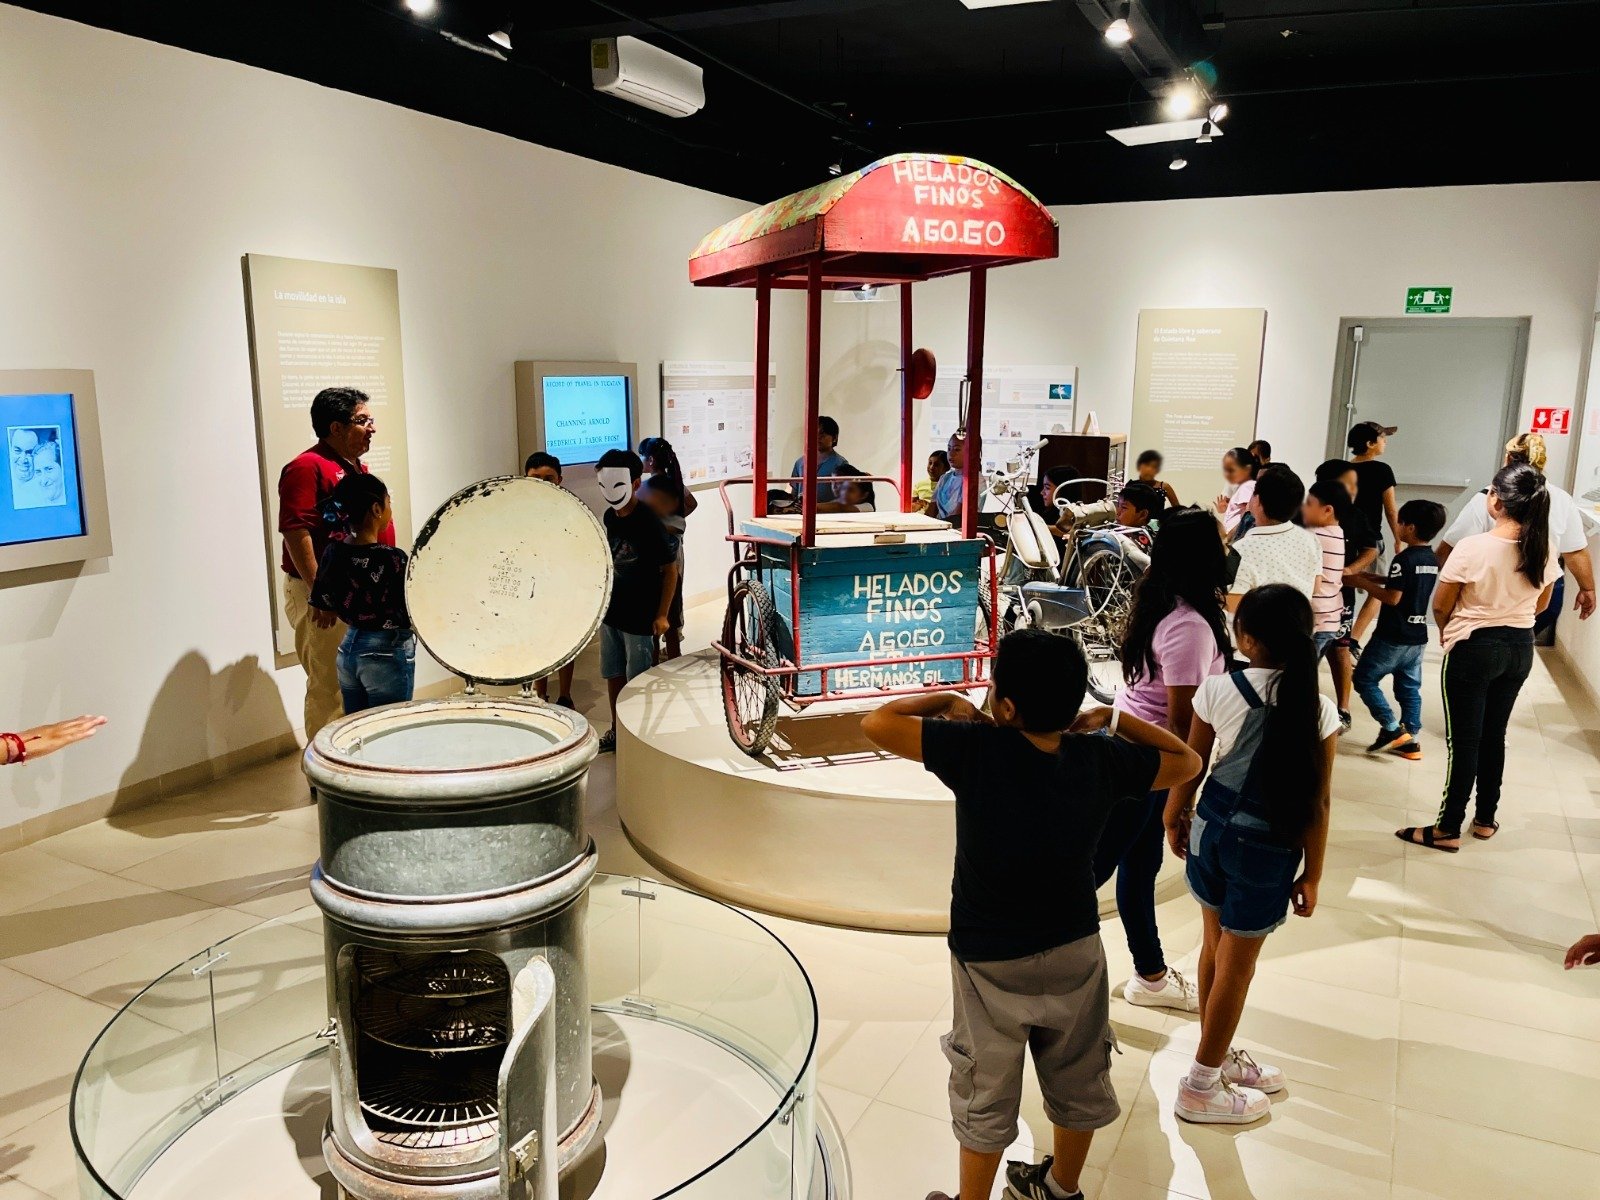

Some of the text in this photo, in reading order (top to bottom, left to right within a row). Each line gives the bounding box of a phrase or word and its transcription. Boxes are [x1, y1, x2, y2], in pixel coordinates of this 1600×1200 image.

[892, 160, 1002, 195] HELADOS
[914, 185, 984, 209] FINOS
[901, 216, 1006, 247] AGO.GO
[853, 570, 964, 600] HELADOS
[866, 597, 943, 624] FINOS
[834, 669, 921, 689] HERMANOS
[923, 669, 945, 684] GIL
